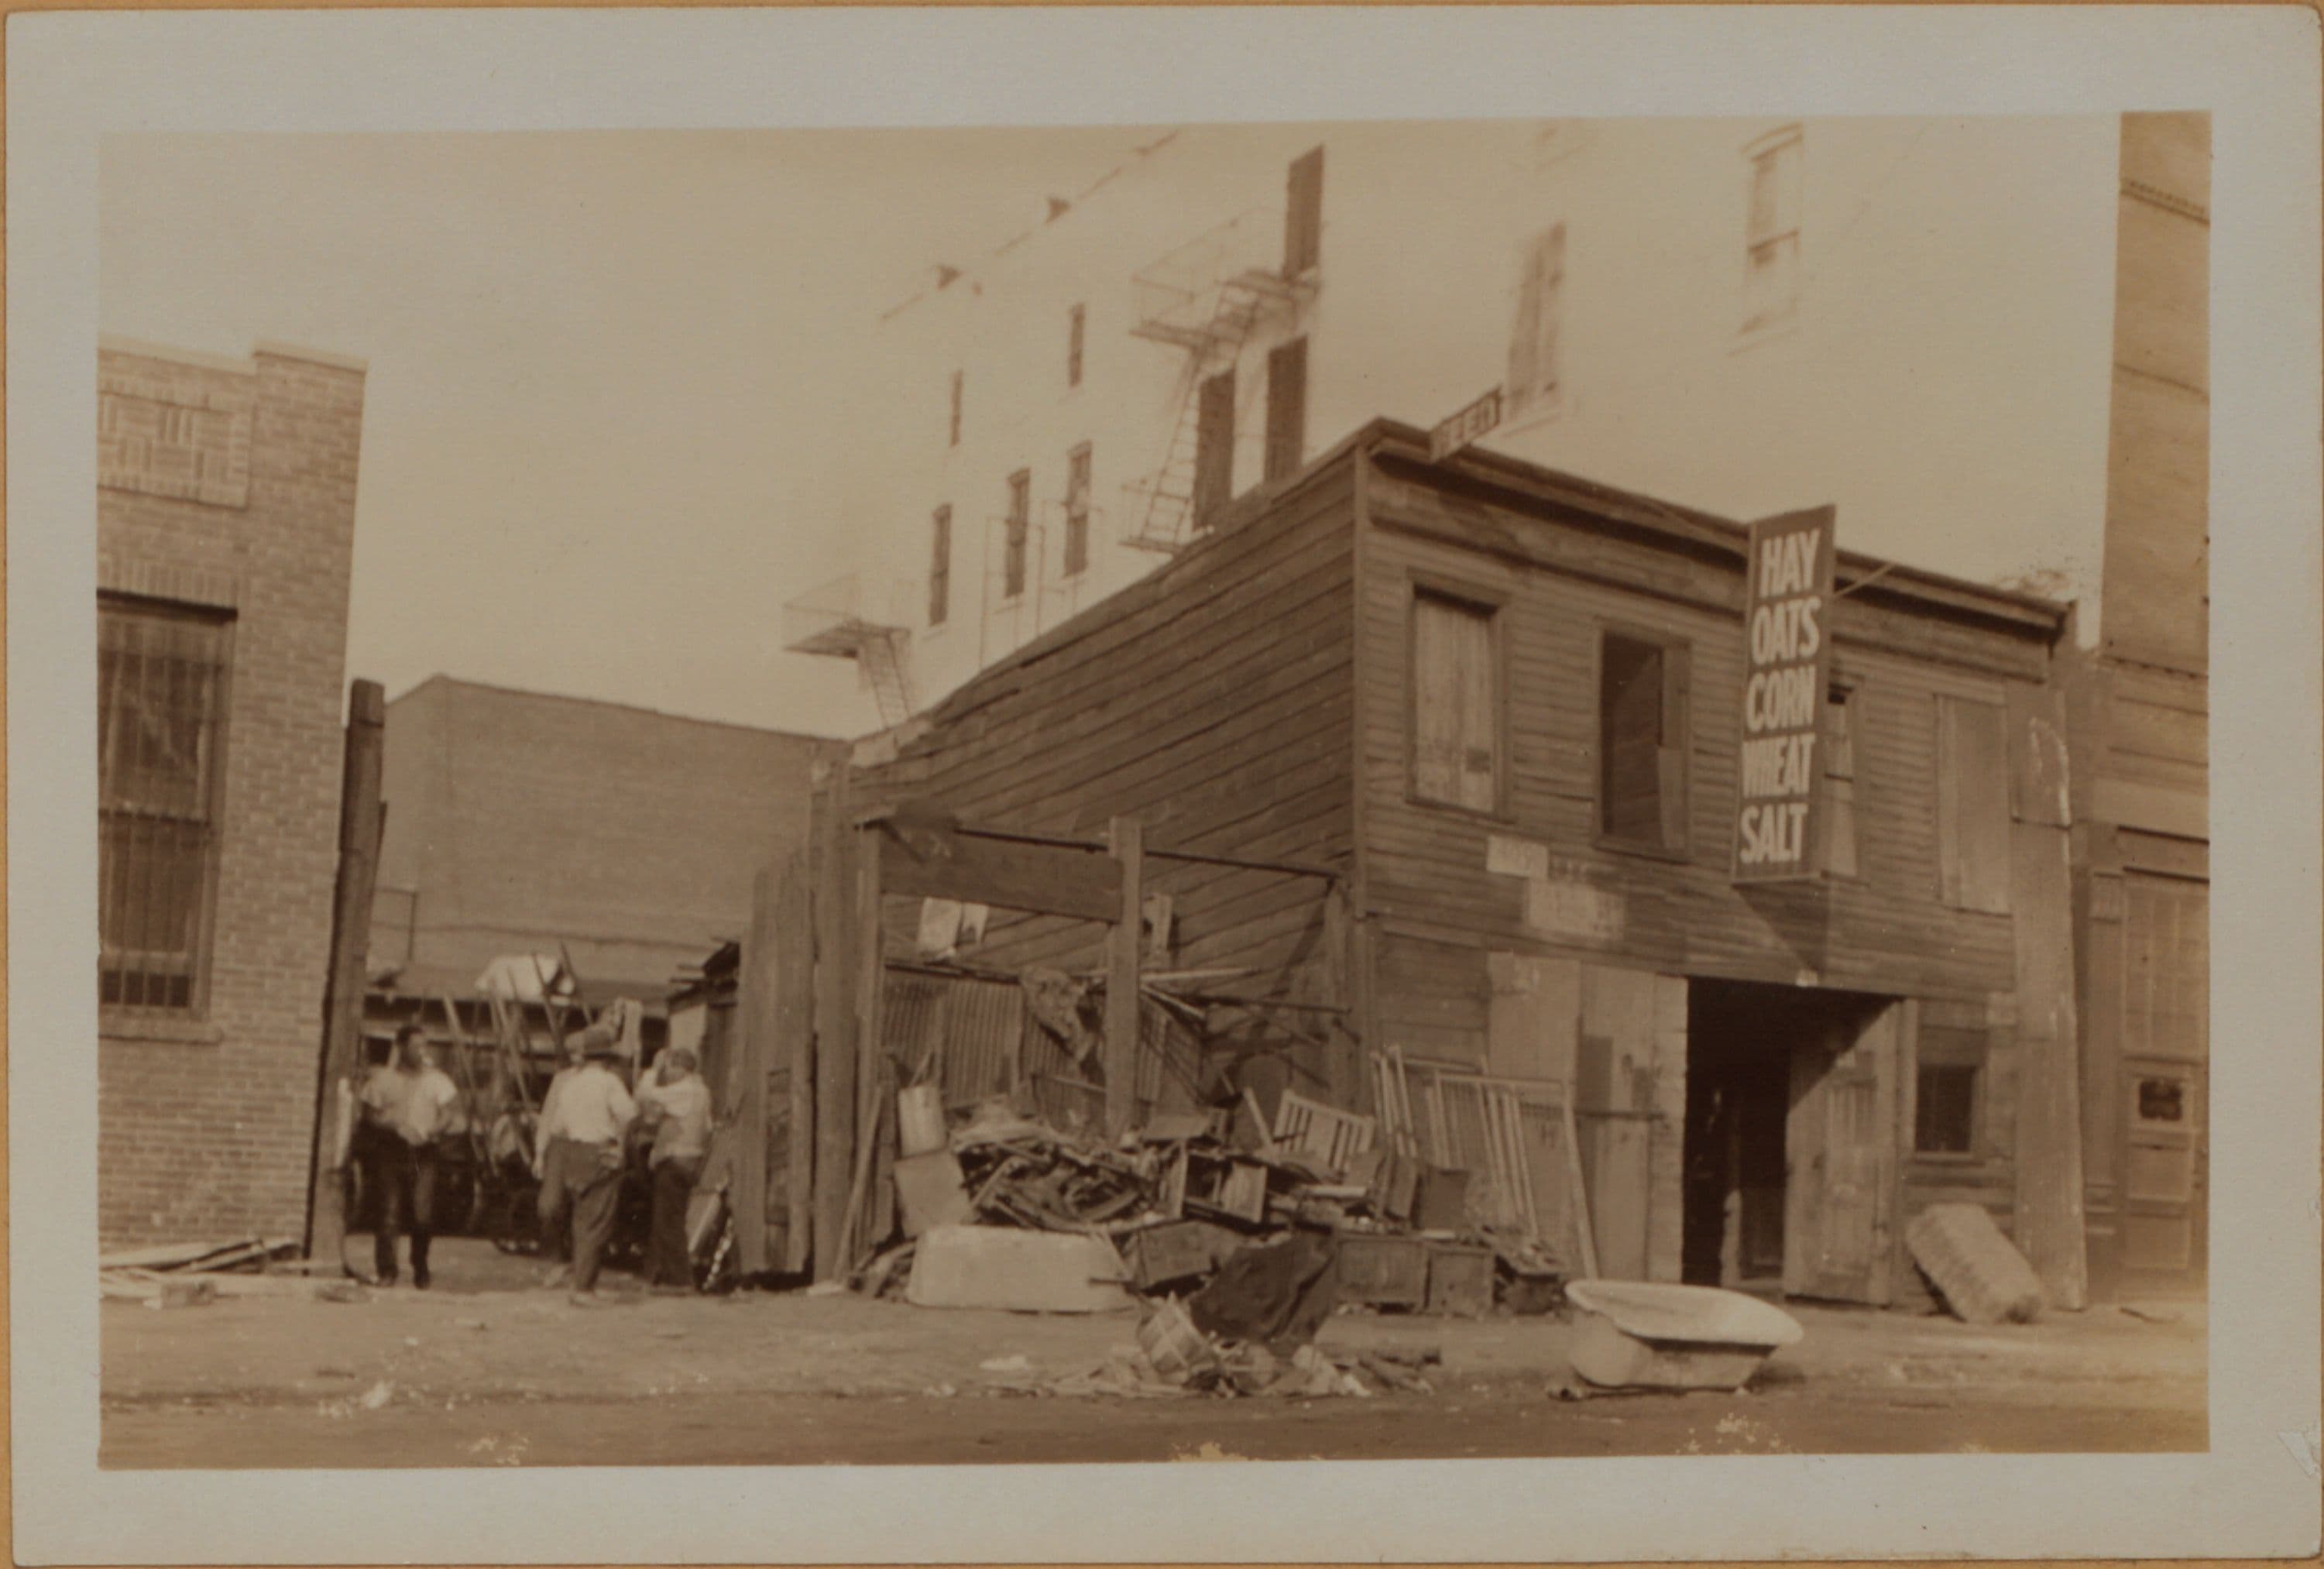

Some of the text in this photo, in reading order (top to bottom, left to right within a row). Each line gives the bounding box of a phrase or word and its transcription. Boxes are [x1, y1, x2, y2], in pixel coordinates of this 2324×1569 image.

[1759, 528, 1821, 598] HAY
[1751, 596, 1821, 665] OATS
[1746, 664, 1816, 733] CORN
[1742, 733, 1816, 799] WHEAT
[1739, 802, 1808, 863] SALT
